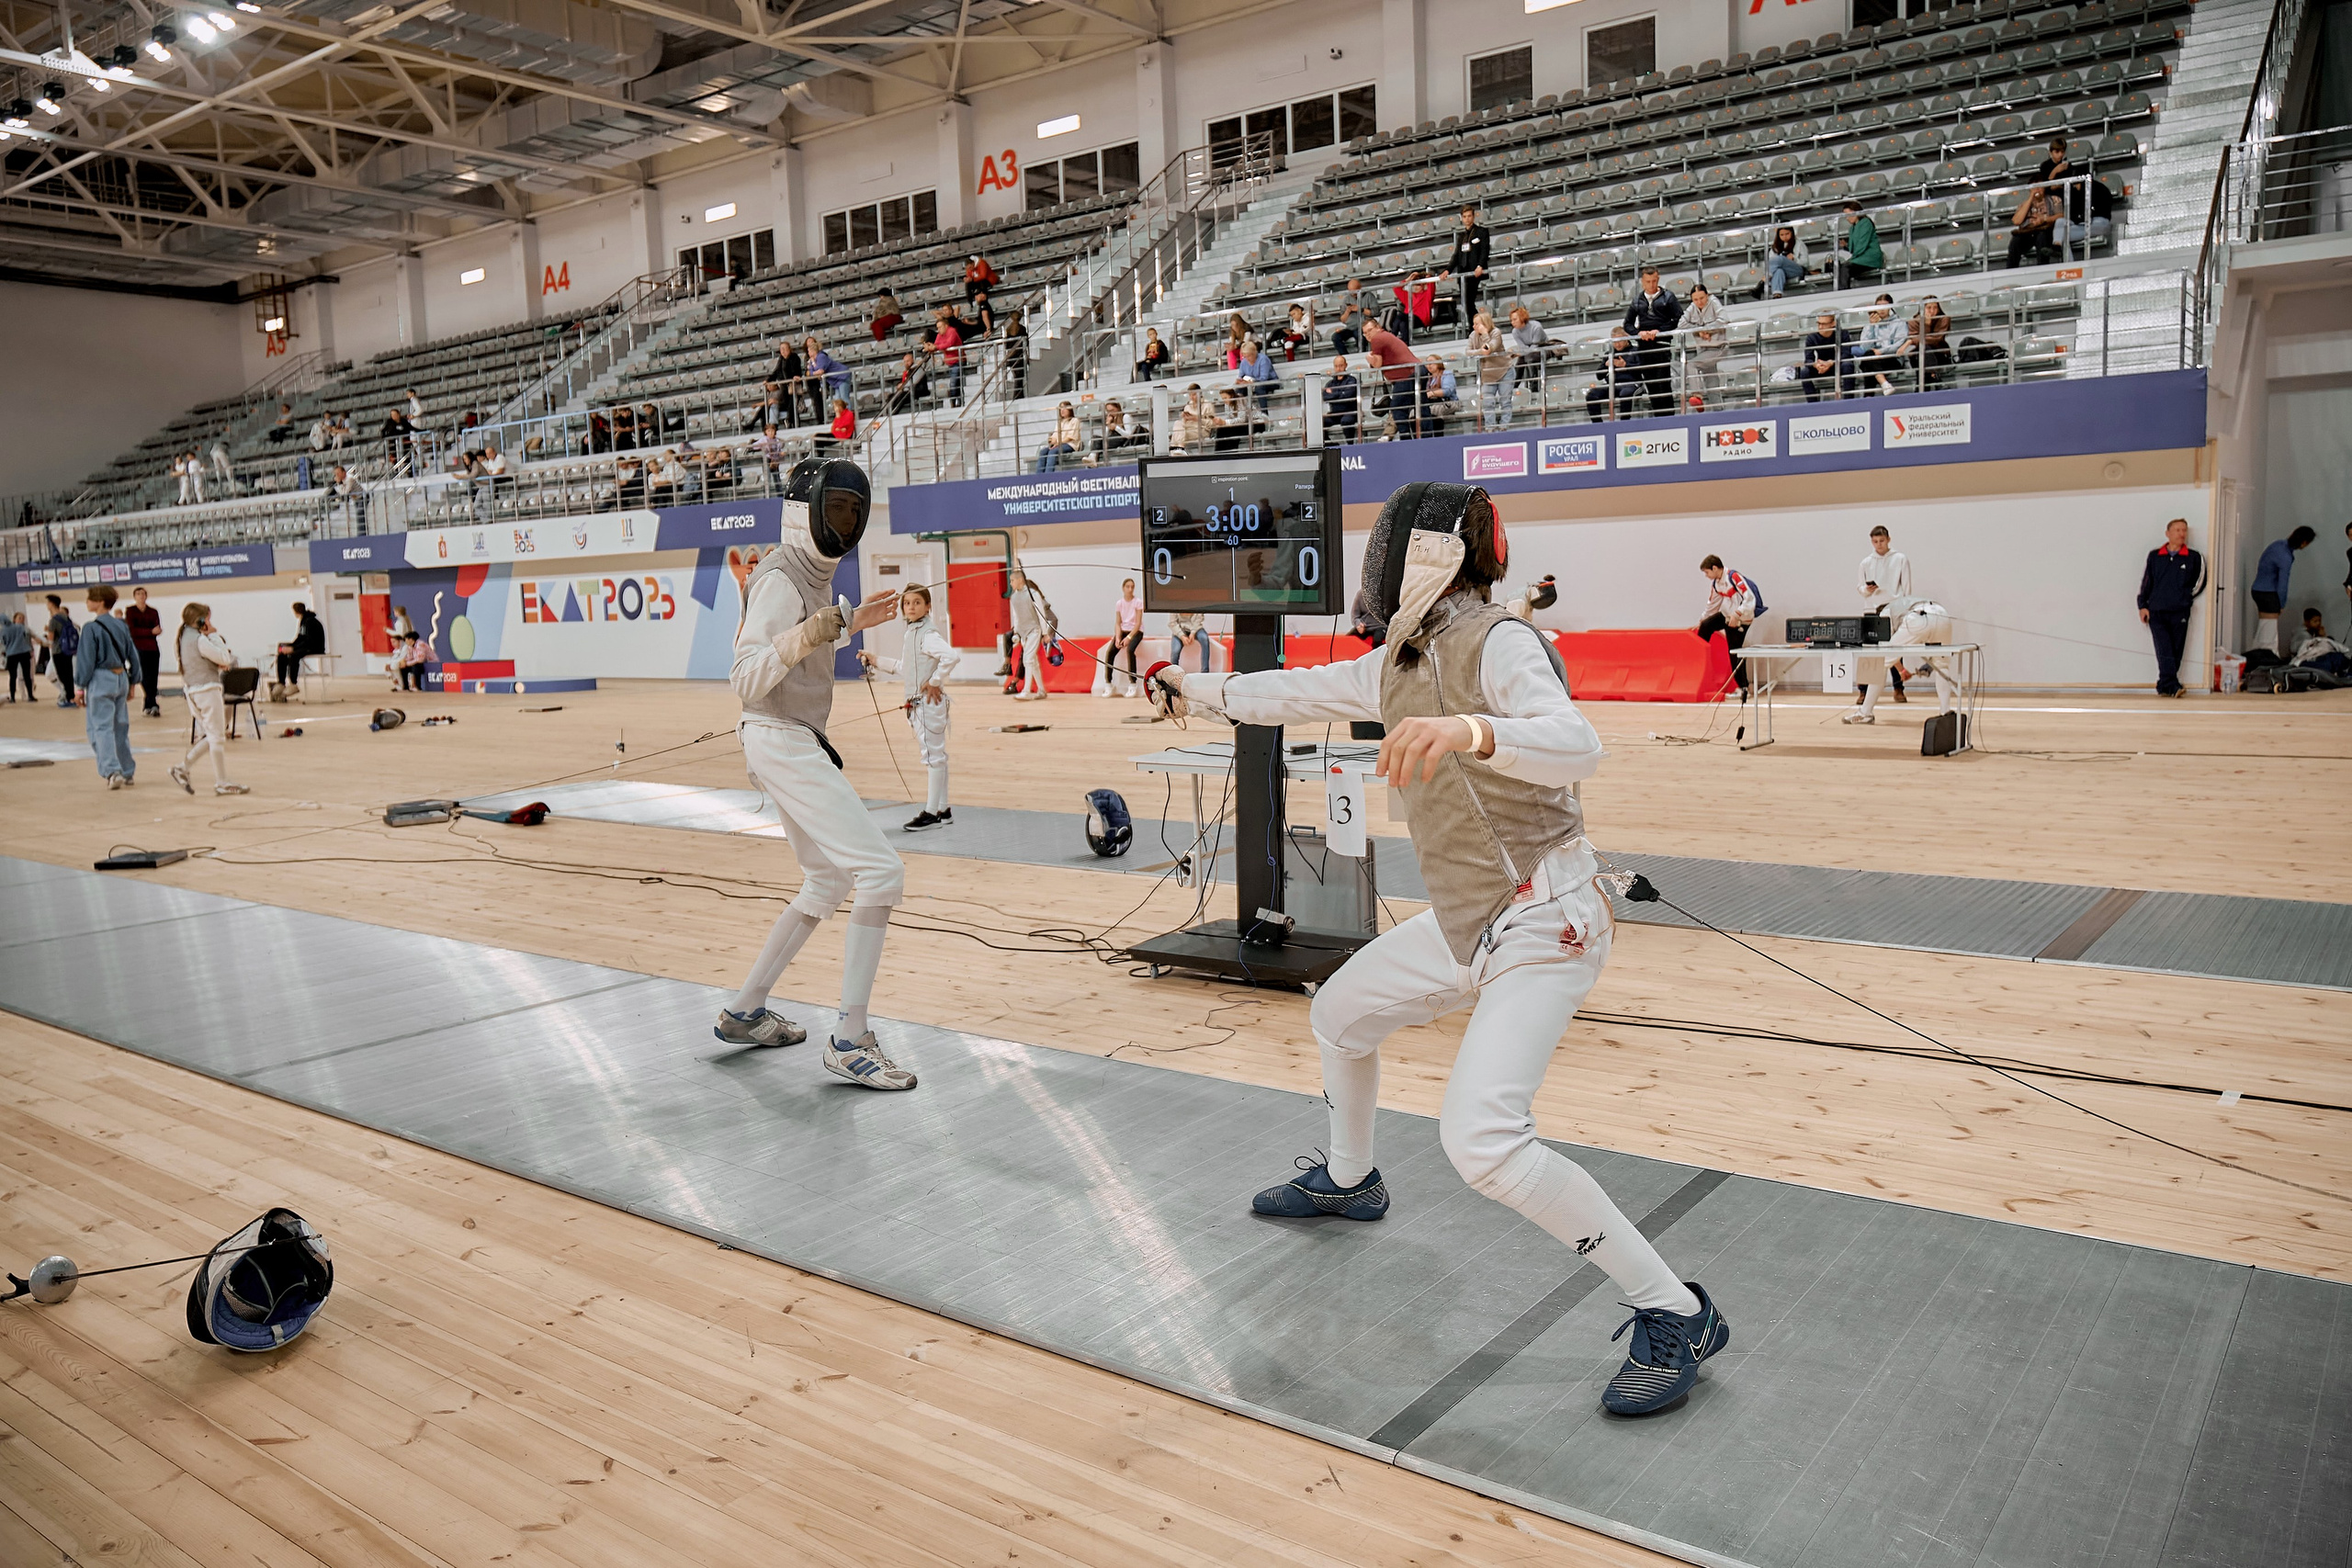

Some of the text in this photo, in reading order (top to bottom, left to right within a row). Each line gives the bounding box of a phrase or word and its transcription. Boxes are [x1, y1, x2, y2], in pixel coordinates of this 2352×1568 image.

[977, 149, 1019, 196] A3
[543, 261, 571, 296] A4
[266, 332, 287, 357] A5
[1908, 412, 1951, 423] Уральский
[1803, 425, 1865, 439] КОЛЬЦОВО
[1907, 420, 1965, 431] федеральный
[1908, 429, 1959, 440] университет
[1549, 443, 1593, 457] РОССИЯ
[1646, 442, 1680, 454] 2ГИС
[1723, 448, 1752, 457] РАДИО
[987, 477, 1079, 501] МЕЖДУНАРОДНЫЙ
[1228, 487, 1234, 502] 1
[1003, 498, 1102, 515] УНИВЕРСИТЕТСКОГО
[710, 514, 756, 530] EKAT2023
[1156, 503, 1313, 533] 2 3:00 2
[1227, 535, 1238, 547] 60
[1153, 546, 1318, 586] 0 0
[520, 577, 675, 624] EKAT2023
[1829, 663, 1846, 678] 15
[1329, 793, 1352, 825] 13
